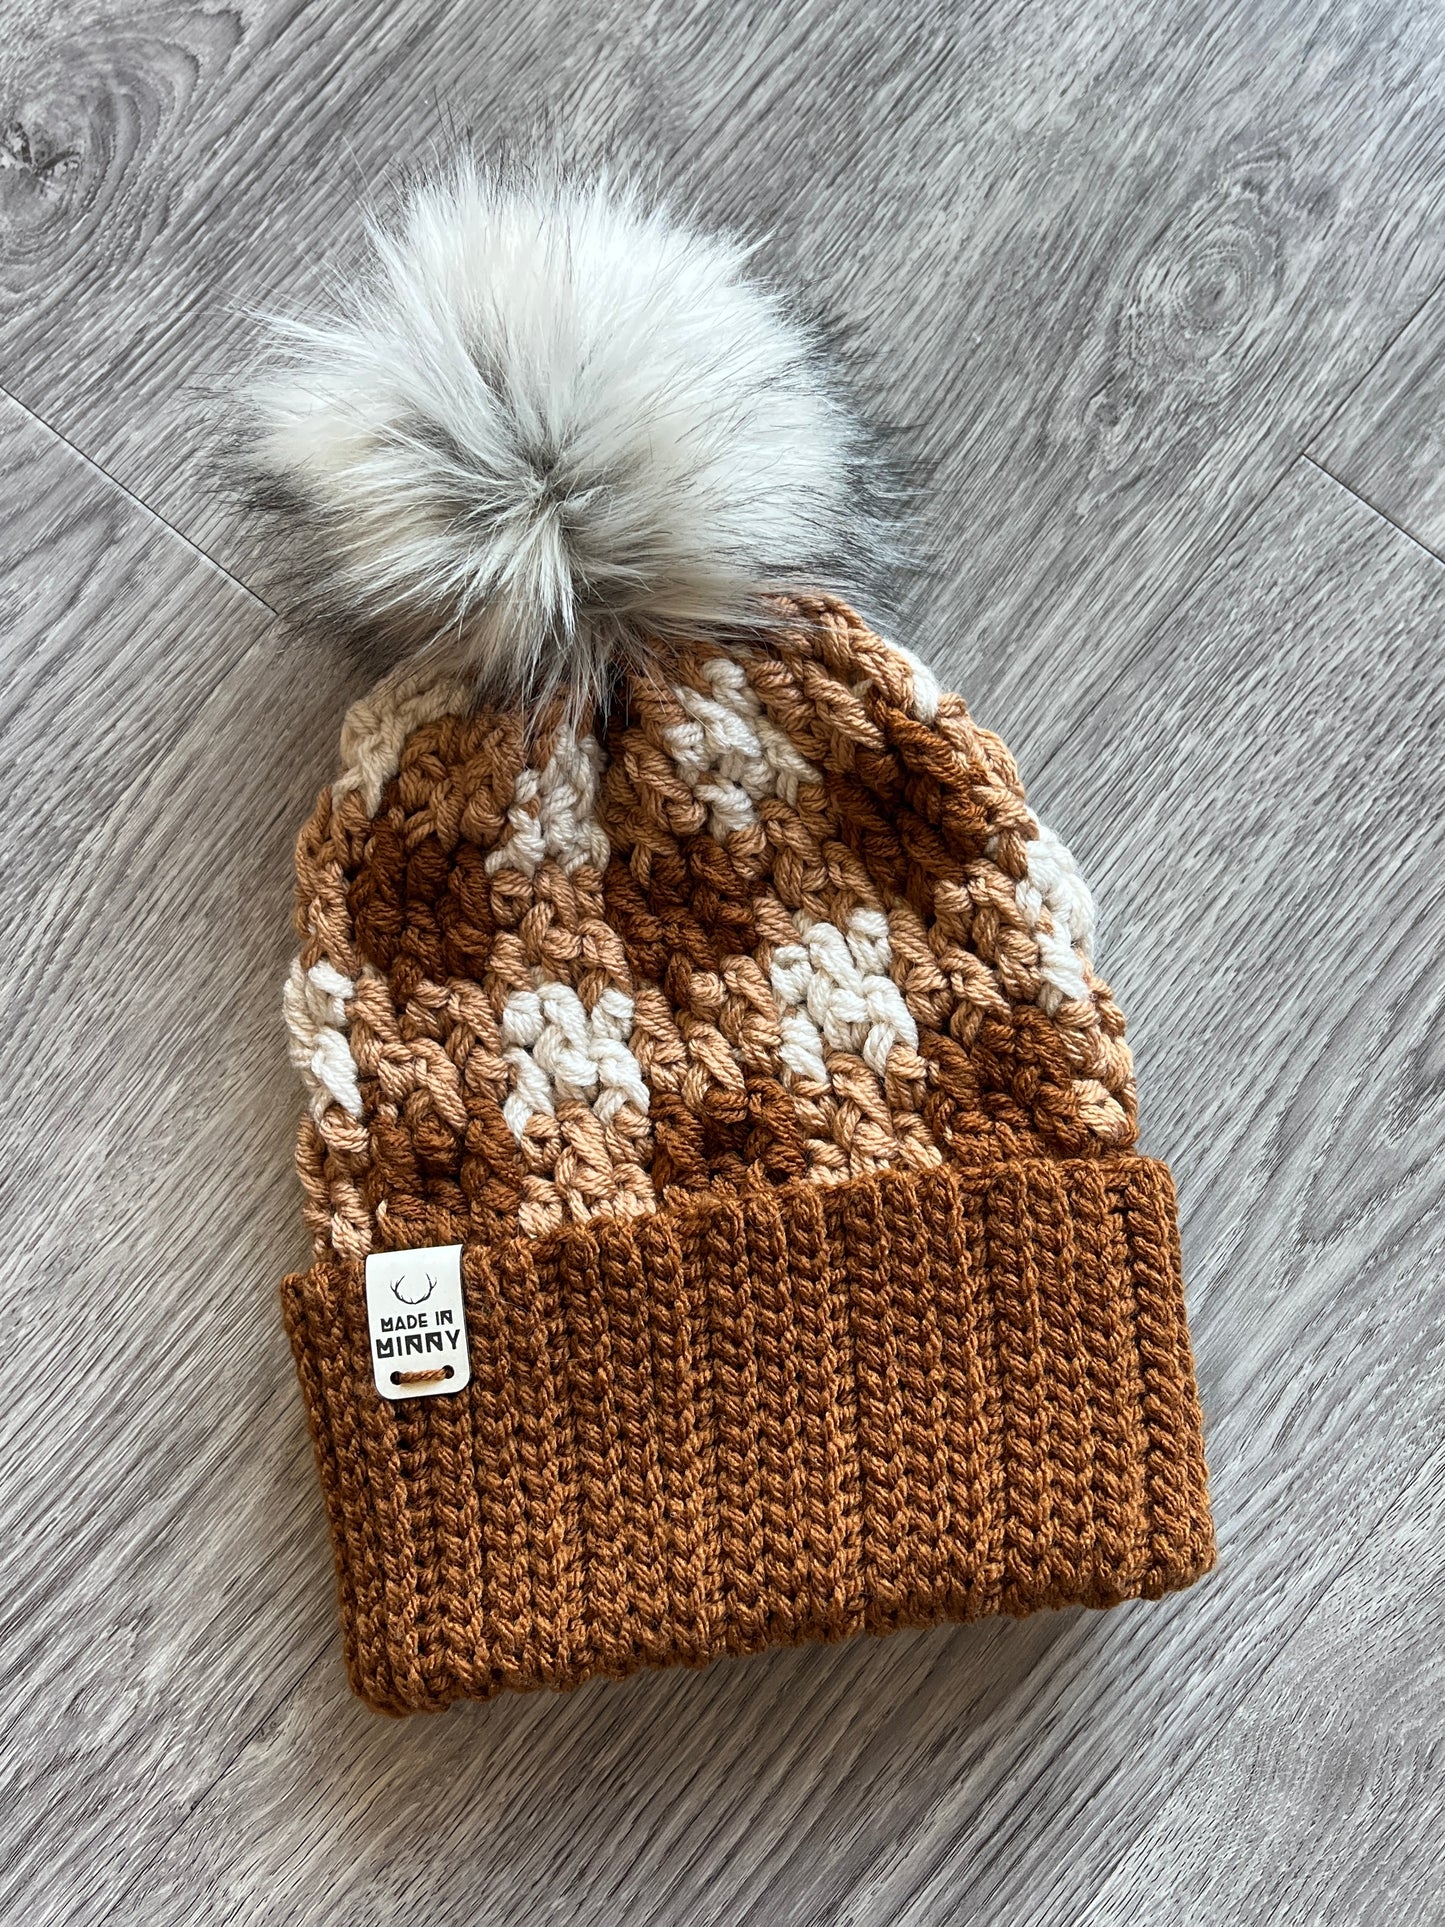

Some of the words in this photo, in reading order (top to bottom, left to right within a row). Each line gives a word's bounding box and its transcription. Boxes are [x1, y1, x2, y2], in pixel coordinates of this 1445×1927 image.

[380, 1312, 428, 1333] MADE
[435, 1309, 453, 1326] IN
[375, 1329, 461, 1359] MINNY
